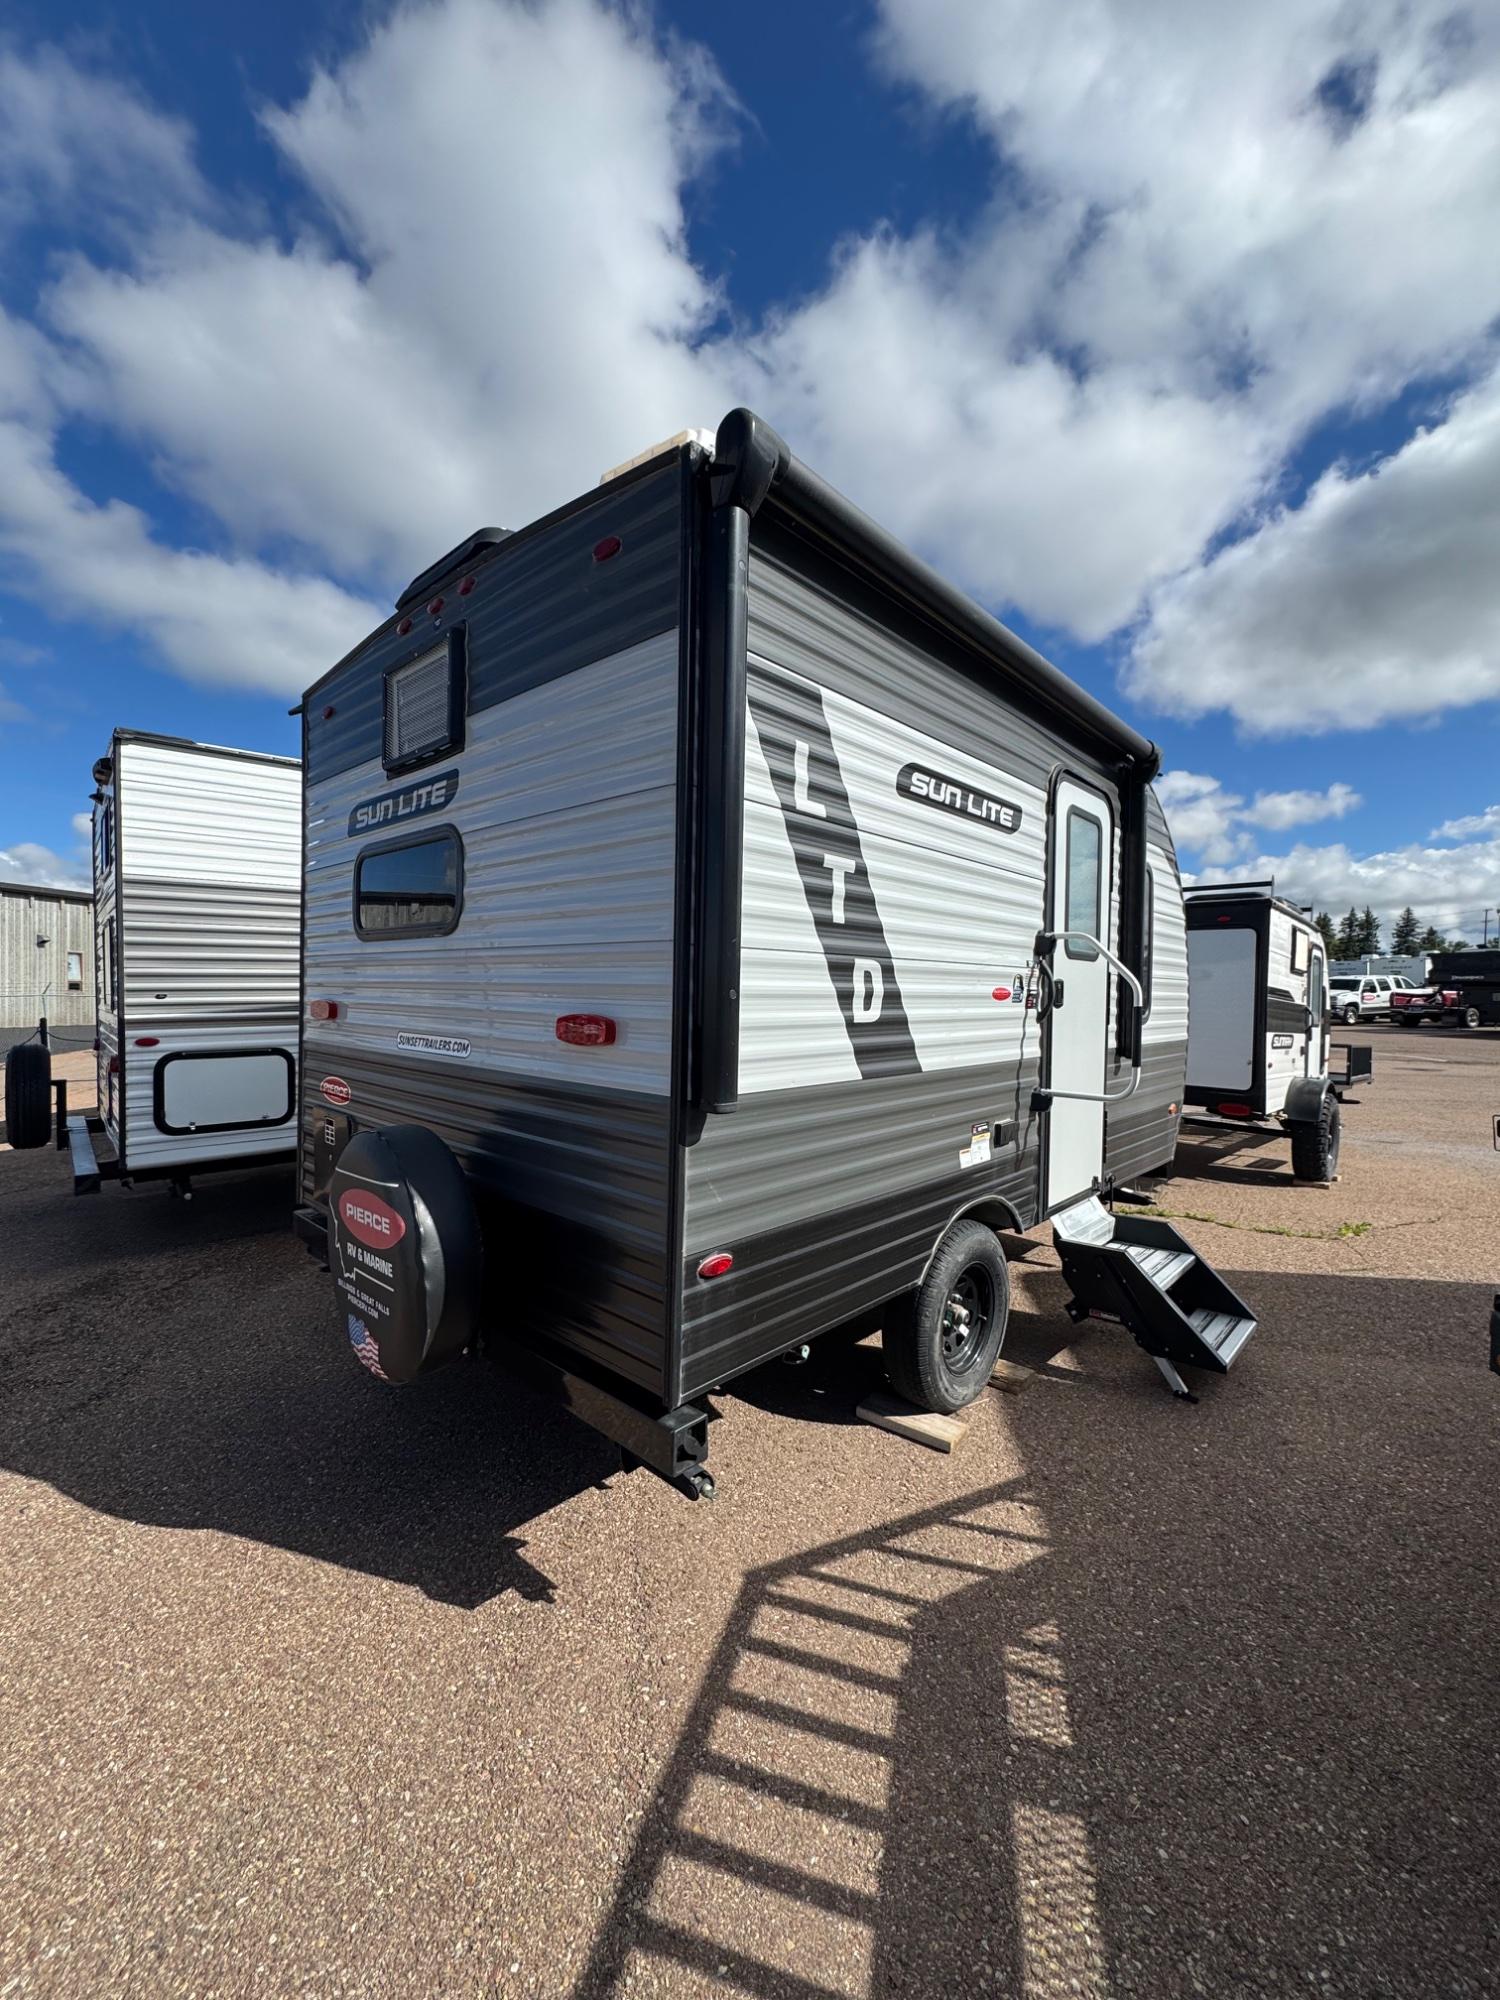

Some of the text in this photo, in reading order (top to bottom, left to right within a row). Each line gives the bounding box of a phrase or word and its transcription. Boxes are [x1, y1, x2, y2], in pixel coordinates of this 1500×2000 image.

[355, 780, 448, 829] SUN LITE
[910, 771, 1014, 828] SUN LITE
[398, 1035, 470, 1054] SUNSETTRAILERS.COM
[323, 1083, 348, 1097] PIERCE
[346, 1203, 390, 1235] PIERCE
[347, 1242, 357, 1258] RV
[363, 1251, 393, 1278] MARINE
[360, 1291, 375, 1307] GREAT
[375, 1300, 390, 1317] FALLS
